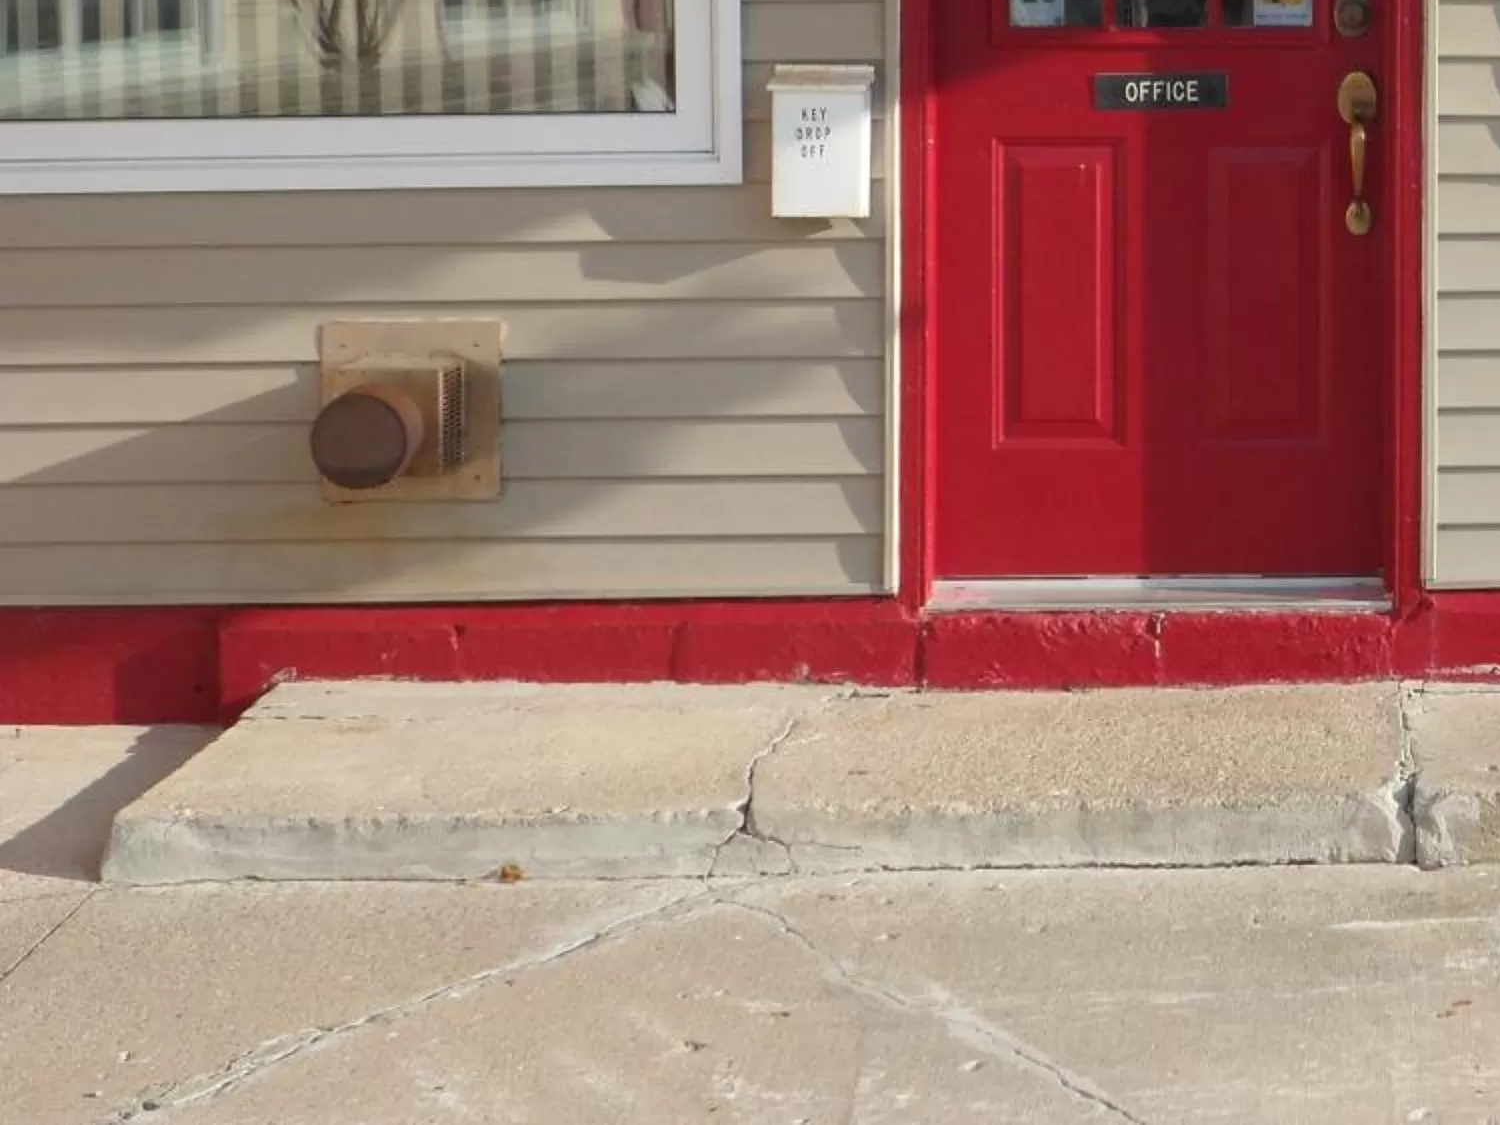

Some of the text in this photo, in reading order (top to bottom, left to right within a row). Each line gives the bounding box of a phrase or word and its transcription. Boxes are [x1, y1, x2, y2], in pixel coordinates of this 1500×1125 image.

[1125, 80, 1200, 103] OFFICE
[801, 106, 828, 122] KEY
[795, 125, 832, 141] DROP
[800, 143, 826, 159] OFF
